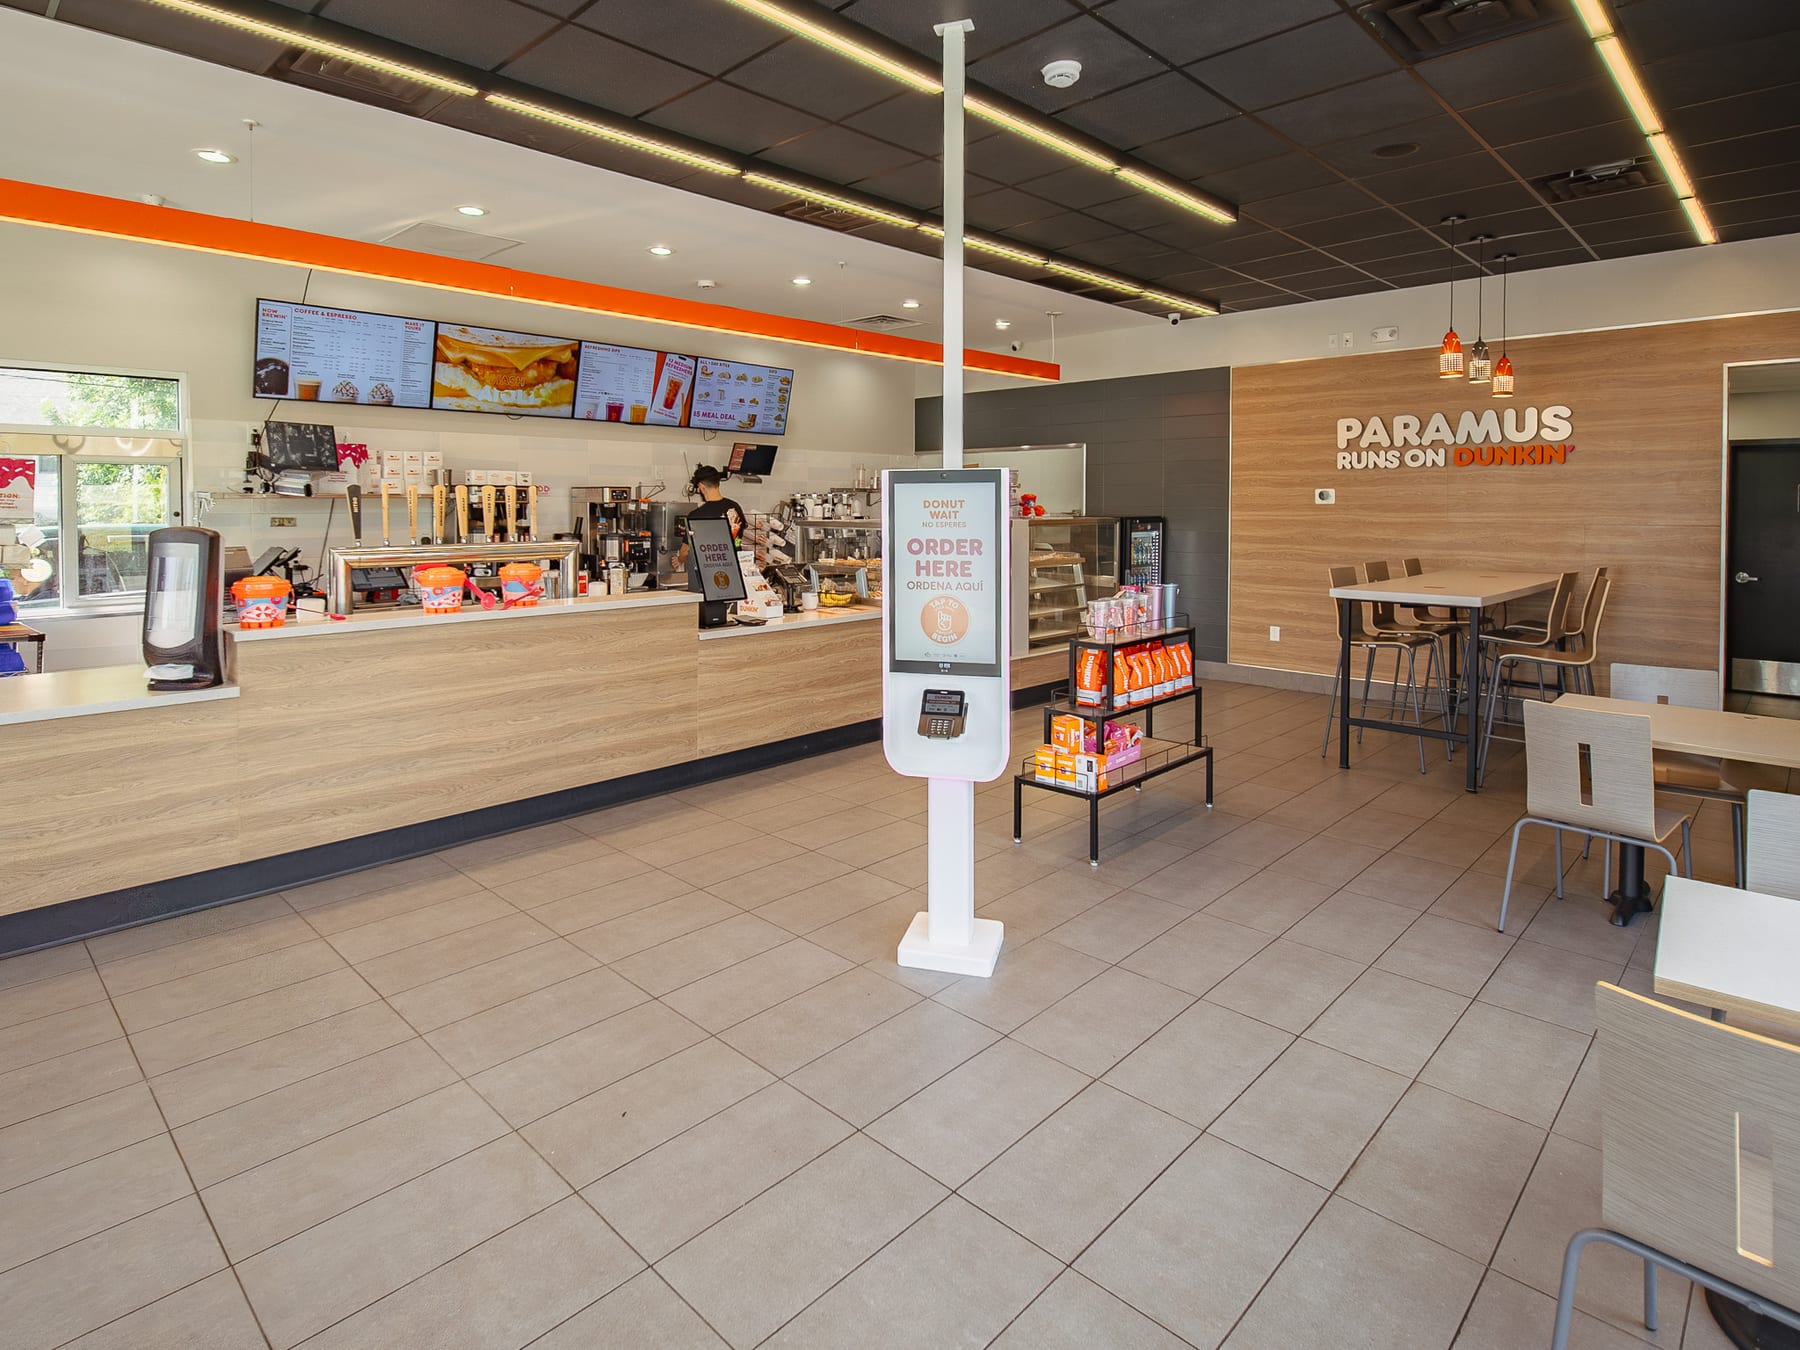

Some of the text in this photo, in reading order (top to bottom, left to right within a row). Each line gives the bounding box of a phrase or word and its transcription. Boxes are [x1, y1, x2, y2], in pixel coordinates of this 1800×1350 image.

[1336, 405, 1573, 449] PARAMUS
[1336, 444, 1575, 470] RUNS ON DUNKIN'
[923, 500, 965, 508] DONUT
[929, 511, 959, 519] WAIT
[699, 544, 729, 552] ORDER
[907, 538, 983, 556] ORDER
[705, 553, 727, 562] HERE
[916, 560, 972, 577] HERE
[907, 580, 983, 591] ORDENA AQUÍ
[948, 599, 959, 608] TO
